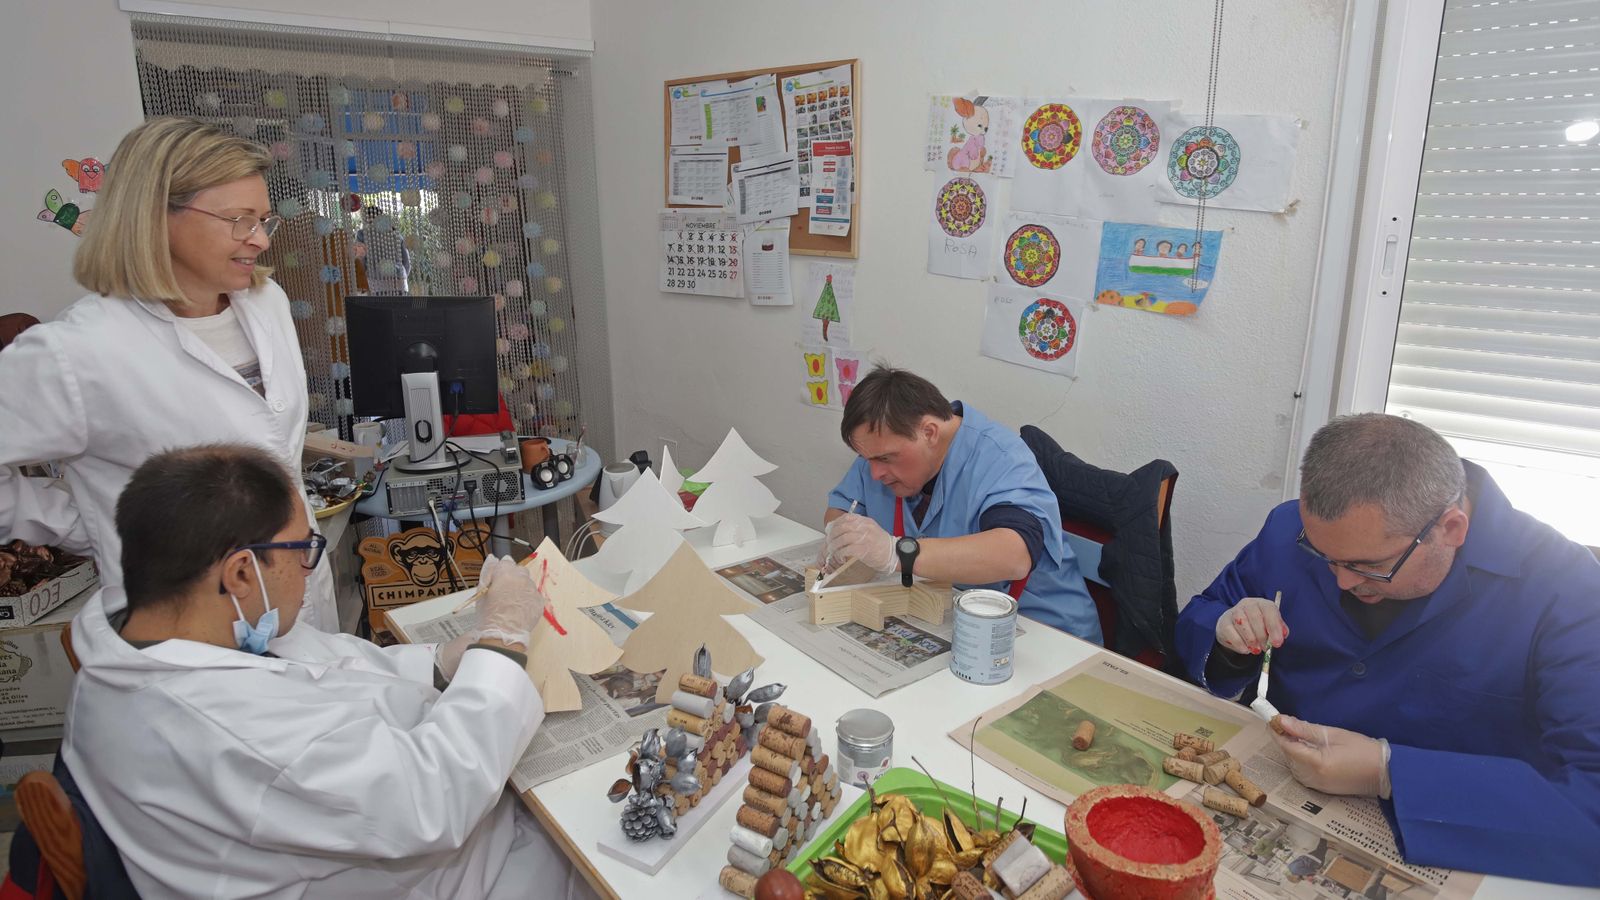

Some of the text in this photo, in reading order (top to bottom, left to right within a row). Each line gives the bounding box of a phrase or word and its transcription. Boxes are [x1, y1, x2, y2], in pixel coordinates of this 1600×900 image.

[688, 232, 694, 241] 2
[699, 232, 704, 241] 3
[708, 233, 714, 241] 4
[720, 233, 725, 241] 5
[677, 244, 683, 252] 8
[687, 245, 693, 253] 9
[697, 245, 704, 253] 10
[708, 245, 714, 253] 11
[718, 245, 726, 254] 12
[667, 256, 675, 264] 14
[676, 256, 684, 265] 15
[686, 256, 694, 264] 16
[708, 257, 715, 266] 18
[718, 257, 726, 267] 19
[729, 258, 738, 267] 20
[668, 267, 738, 280] 21 22 23 24 25 26 27
[667, 279, 696, 289] 28 29 30
[30, 581, 61, 617] ECO
[1330, 819, 1363, 838] plena
[1325, 823, 1380, 855] laborales
[1364, 836, 1389, 852] vida
